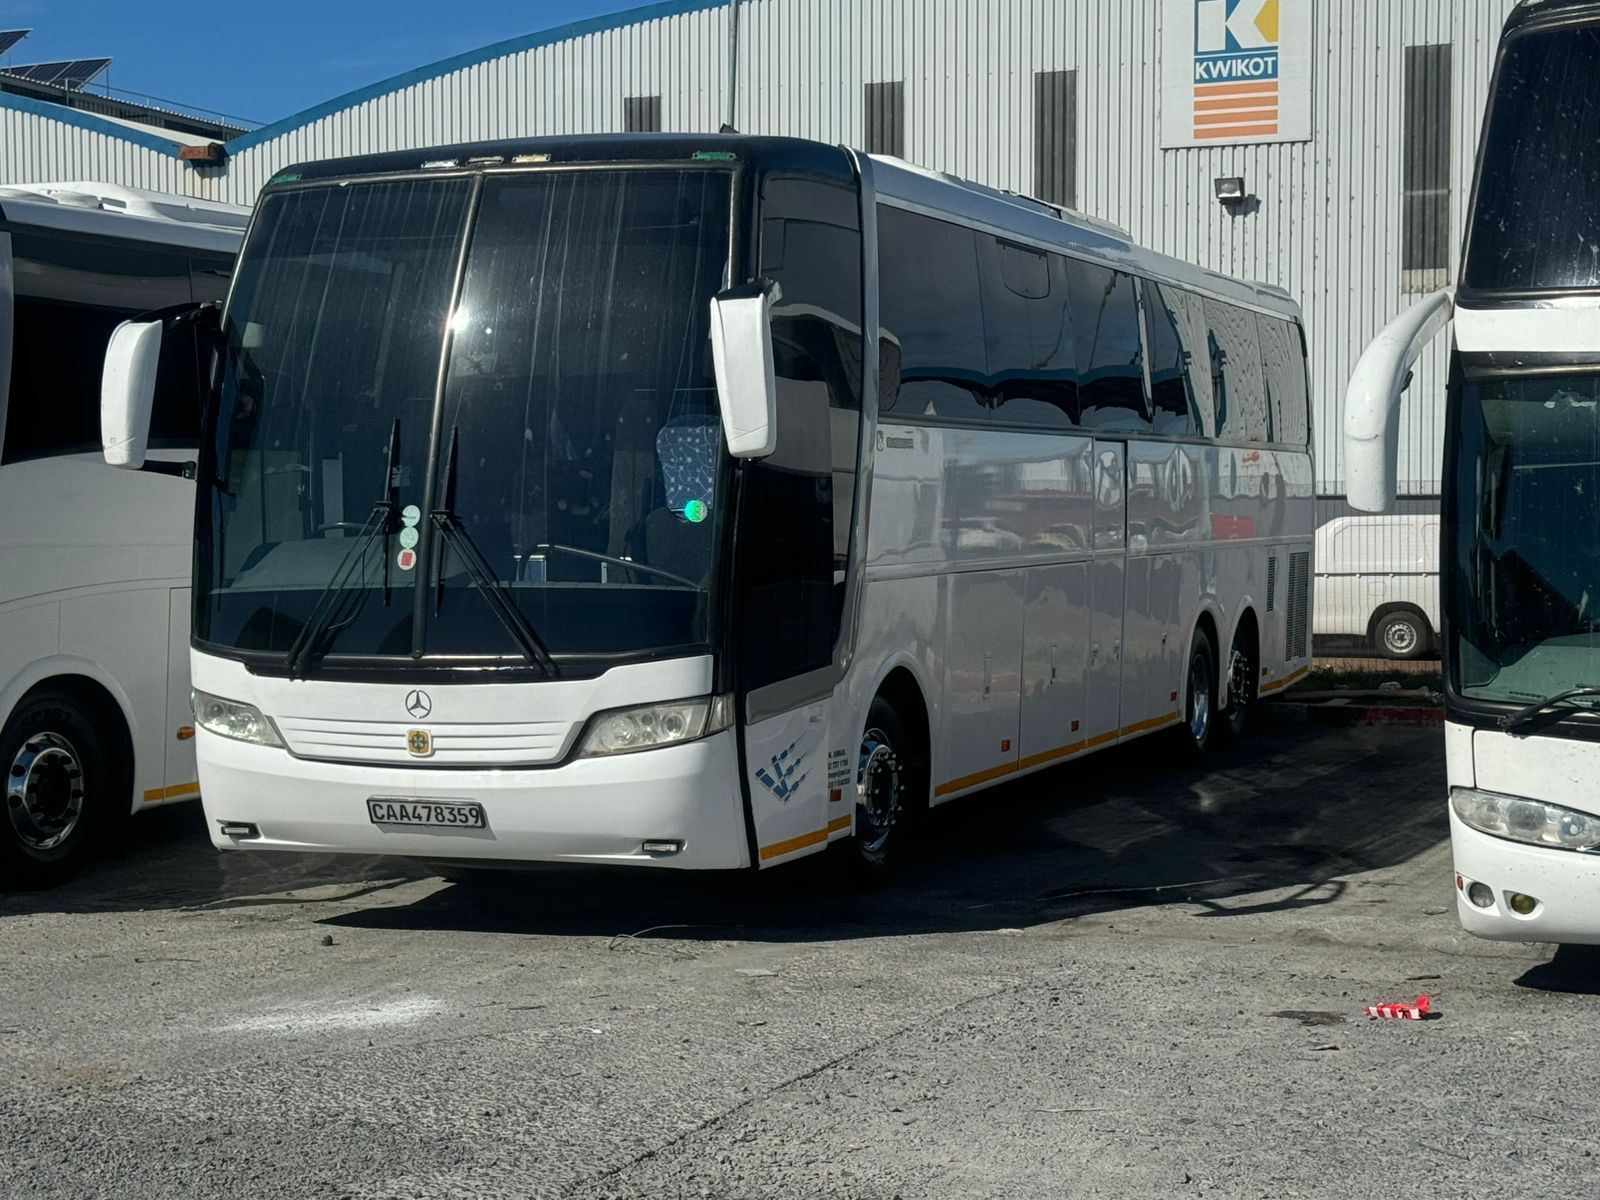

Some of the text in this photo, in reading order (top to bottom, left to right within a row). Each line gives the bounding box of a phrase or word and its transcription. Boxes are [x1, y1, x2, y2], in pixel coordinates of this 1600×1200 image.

[1198, 0, 1278, 52] K
[1195, 57, 1276, 80] KWIKOT
[372, 803, 480, 825] CAA478359
